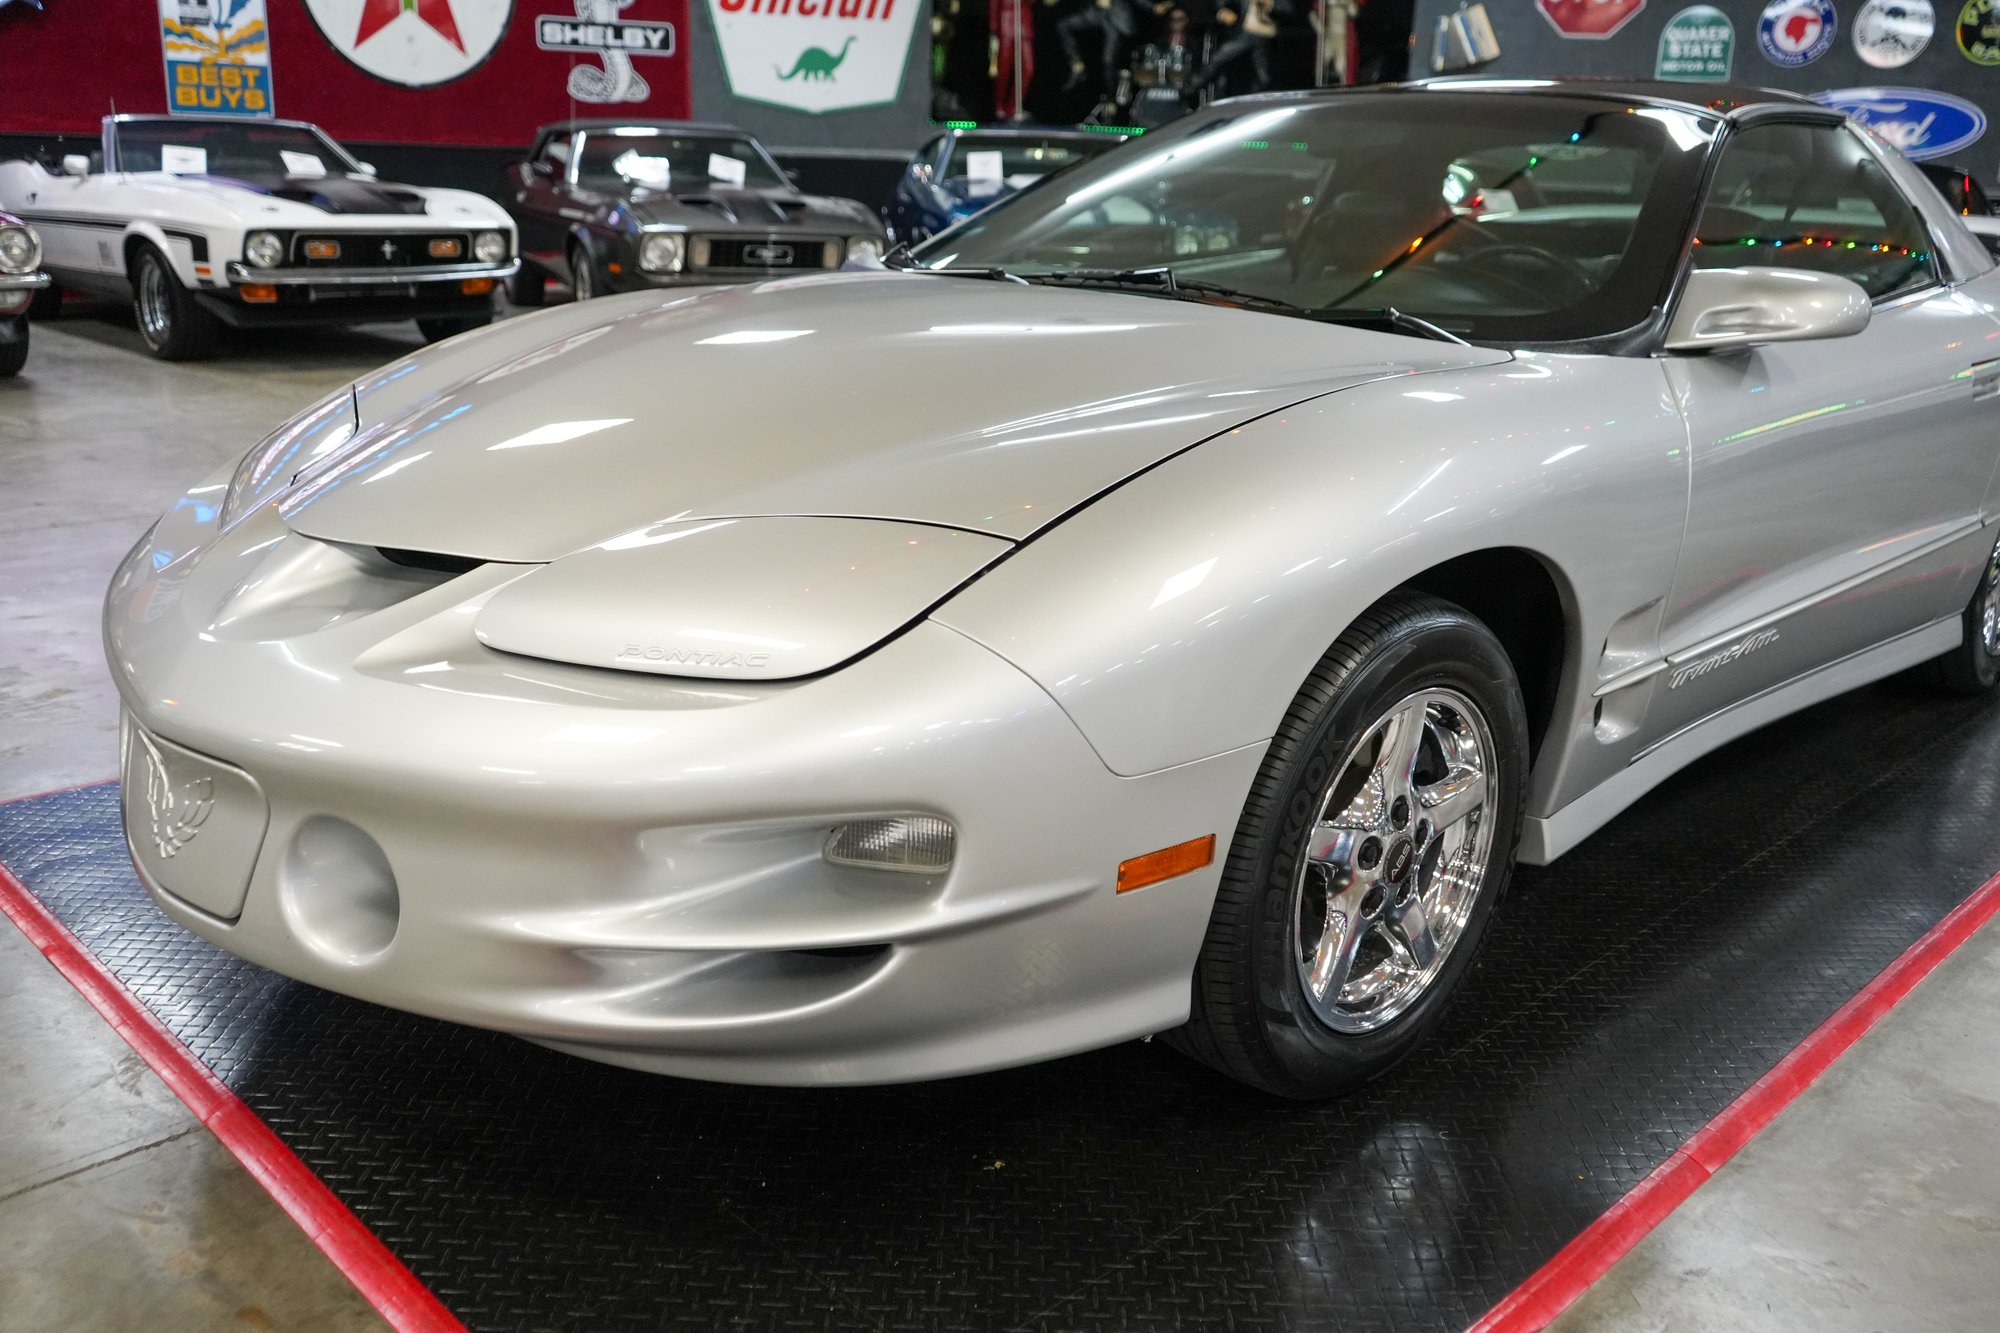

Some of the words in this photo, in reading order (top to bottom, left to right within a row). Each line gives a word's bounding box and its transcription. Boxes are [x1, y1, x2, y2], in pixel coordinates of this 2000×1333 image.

[542, 22, 667, 48] SHELBY
[1667, 26, 1730, 42] QUAKER
[1669, 42, 1723, 58] STATE
[176, 64, 261, 88] BEST
[1662, 60, 1704, 72] MOTOR
[1706, 60, 1728, 72] OIL
[176, 85, 266, 110] BUYS
[616, 644, 769, 668] PONTIAC
[1391, 843, 1411, 881] ABS
